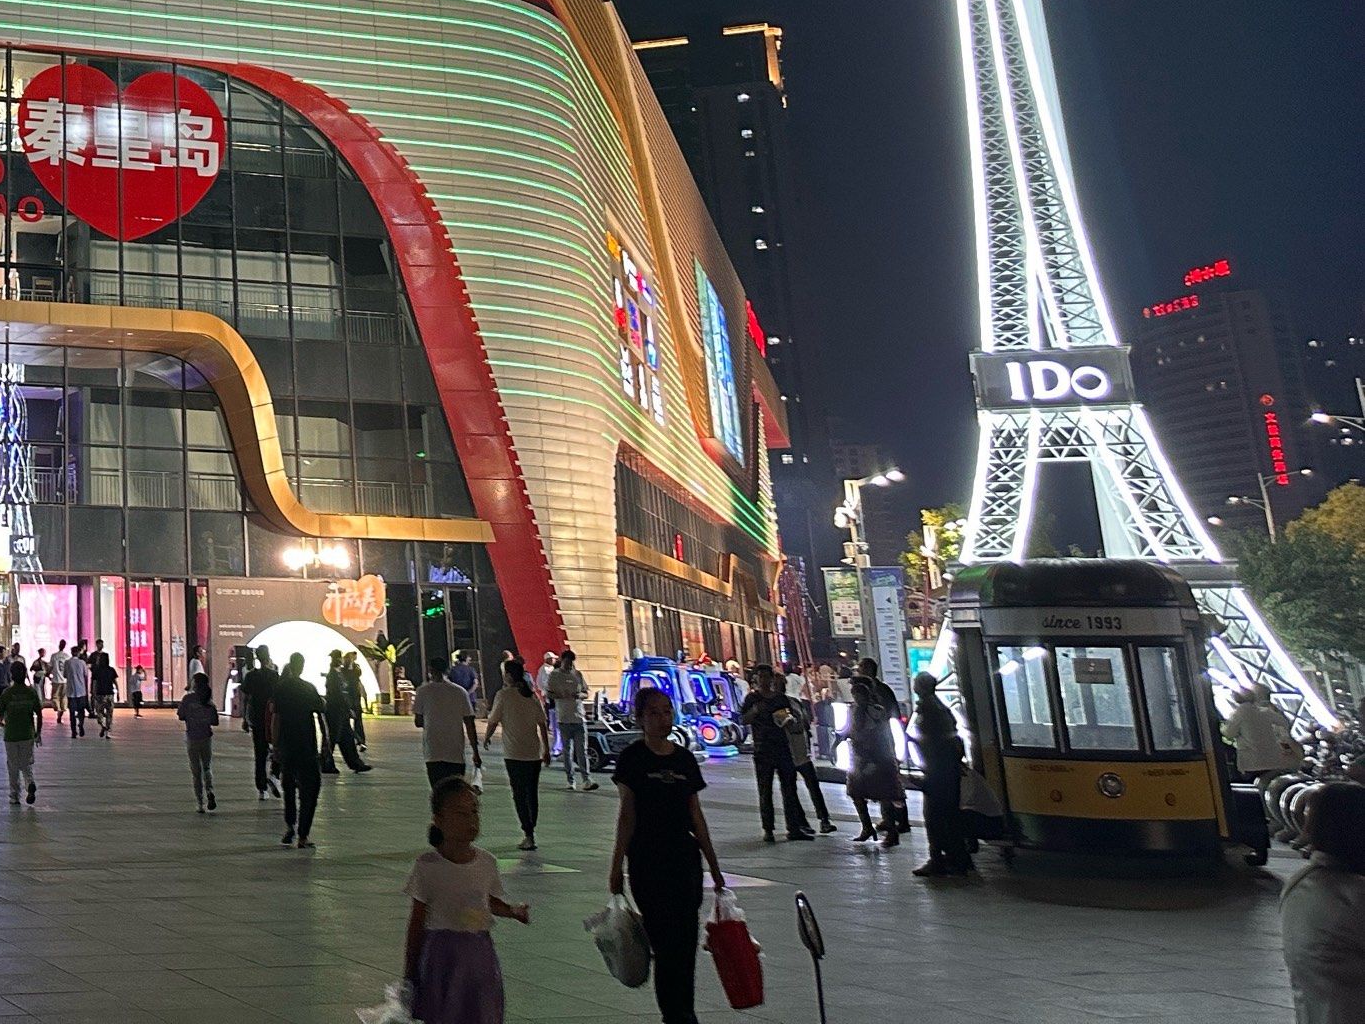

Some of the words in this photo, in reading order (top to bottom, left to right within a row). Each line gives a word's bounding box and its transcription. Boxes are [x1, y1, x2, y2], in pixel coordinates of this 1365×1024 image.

[23, 96, 223, 178] 秦皇岛
[1041, 614, 1082, 629] since
[1087, 615, 1122, 630] 1993
